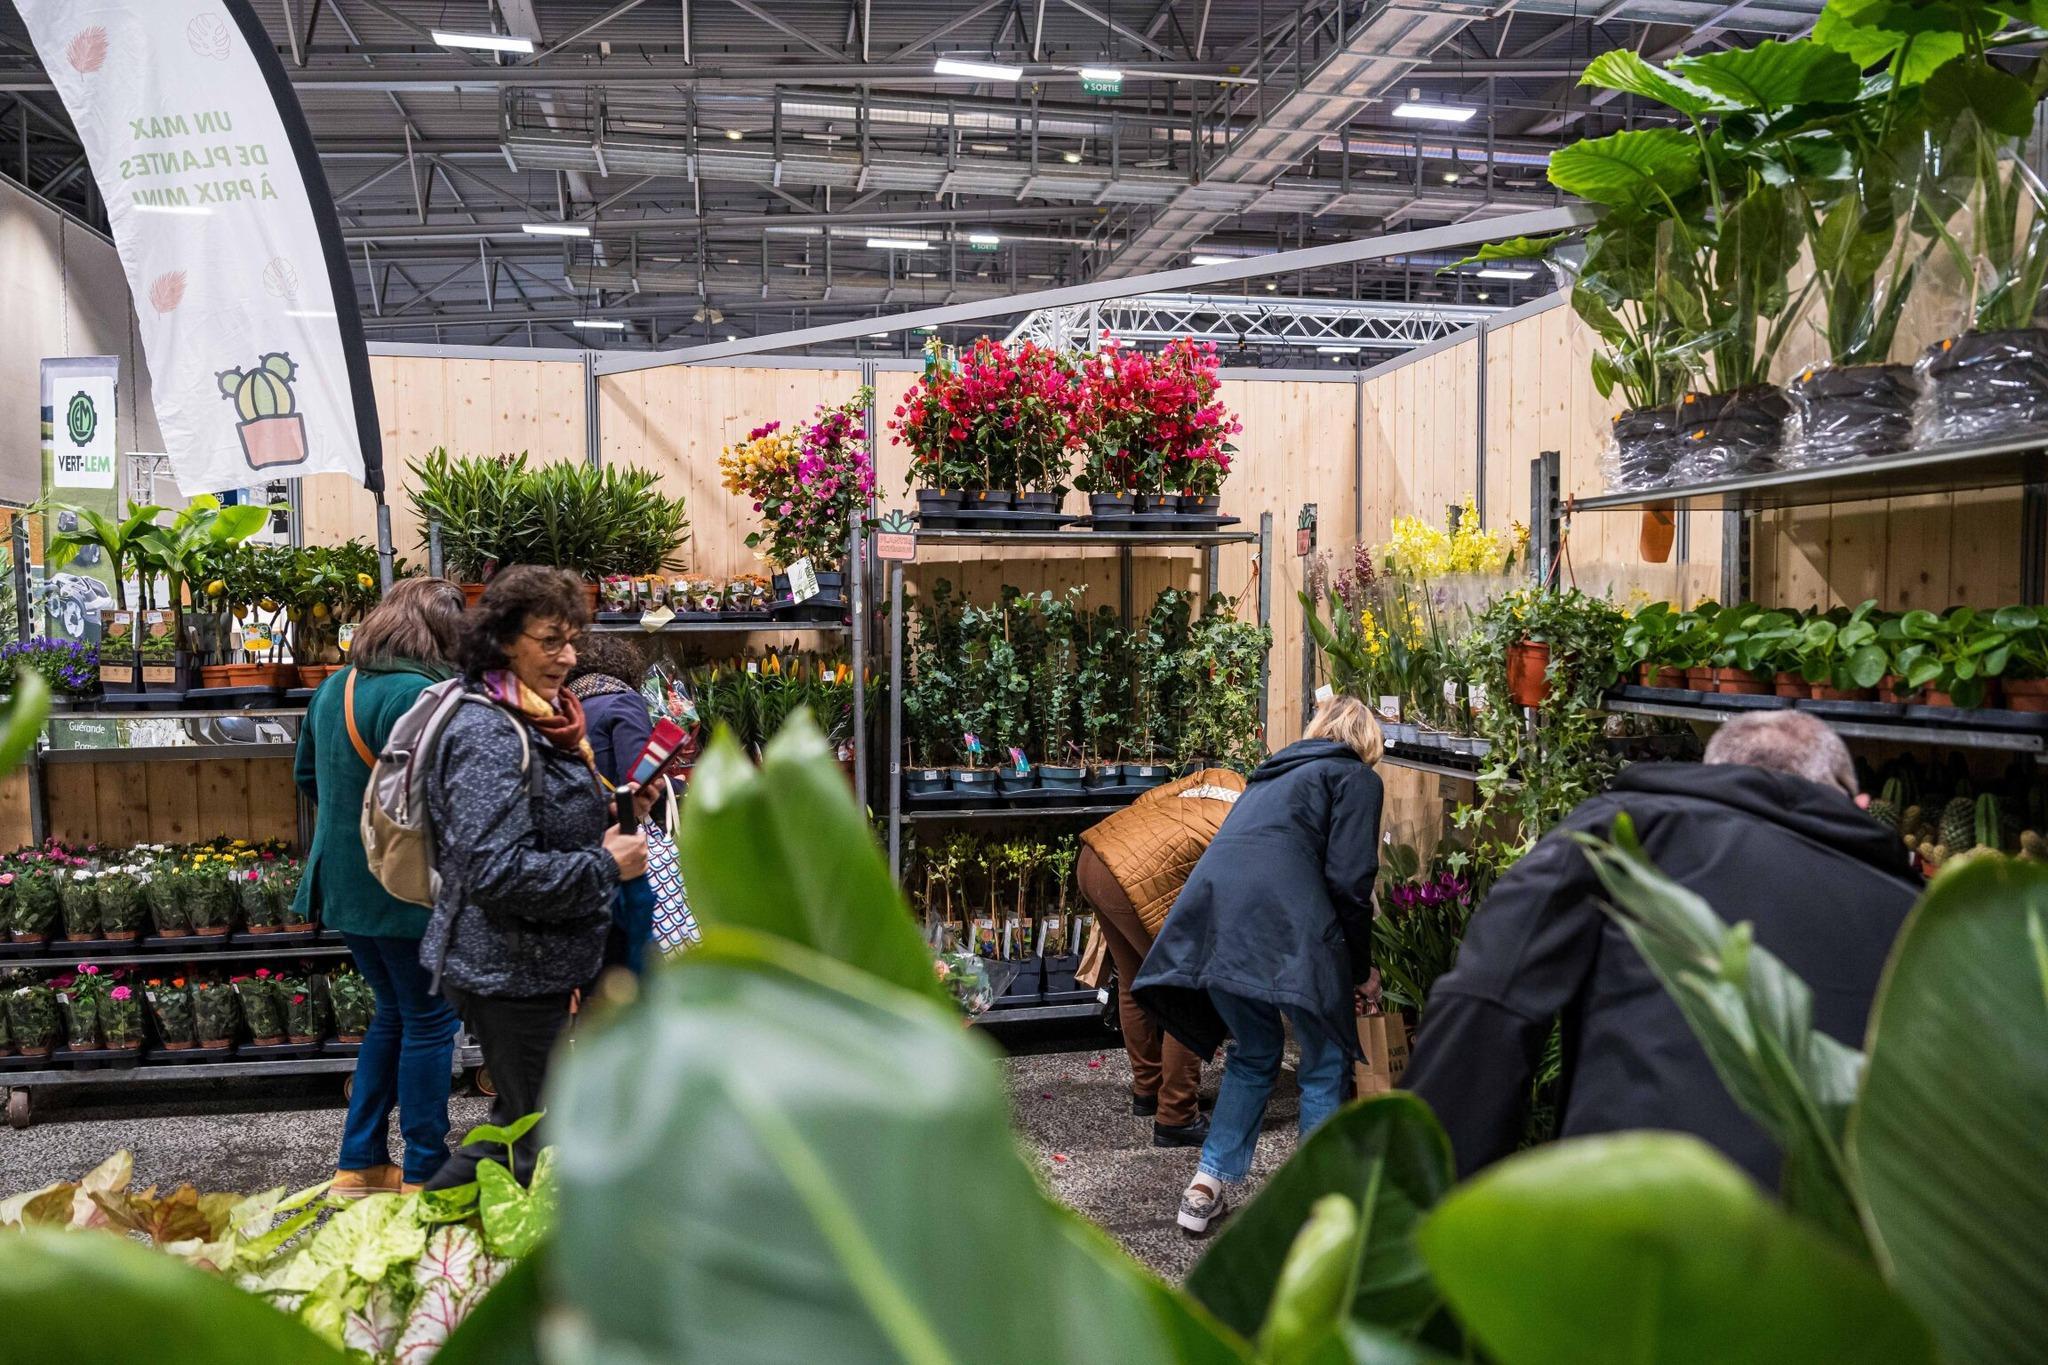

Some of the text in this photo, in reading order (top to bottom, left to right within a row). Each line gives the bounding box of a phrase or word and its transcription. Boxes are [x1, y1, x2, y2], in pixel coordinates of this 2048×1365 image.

[1090, 82, 1120, 93] SORTIE
[58, 455, 110, 472] VERT-LEM
[69, 720, 106, 734] Guérande
